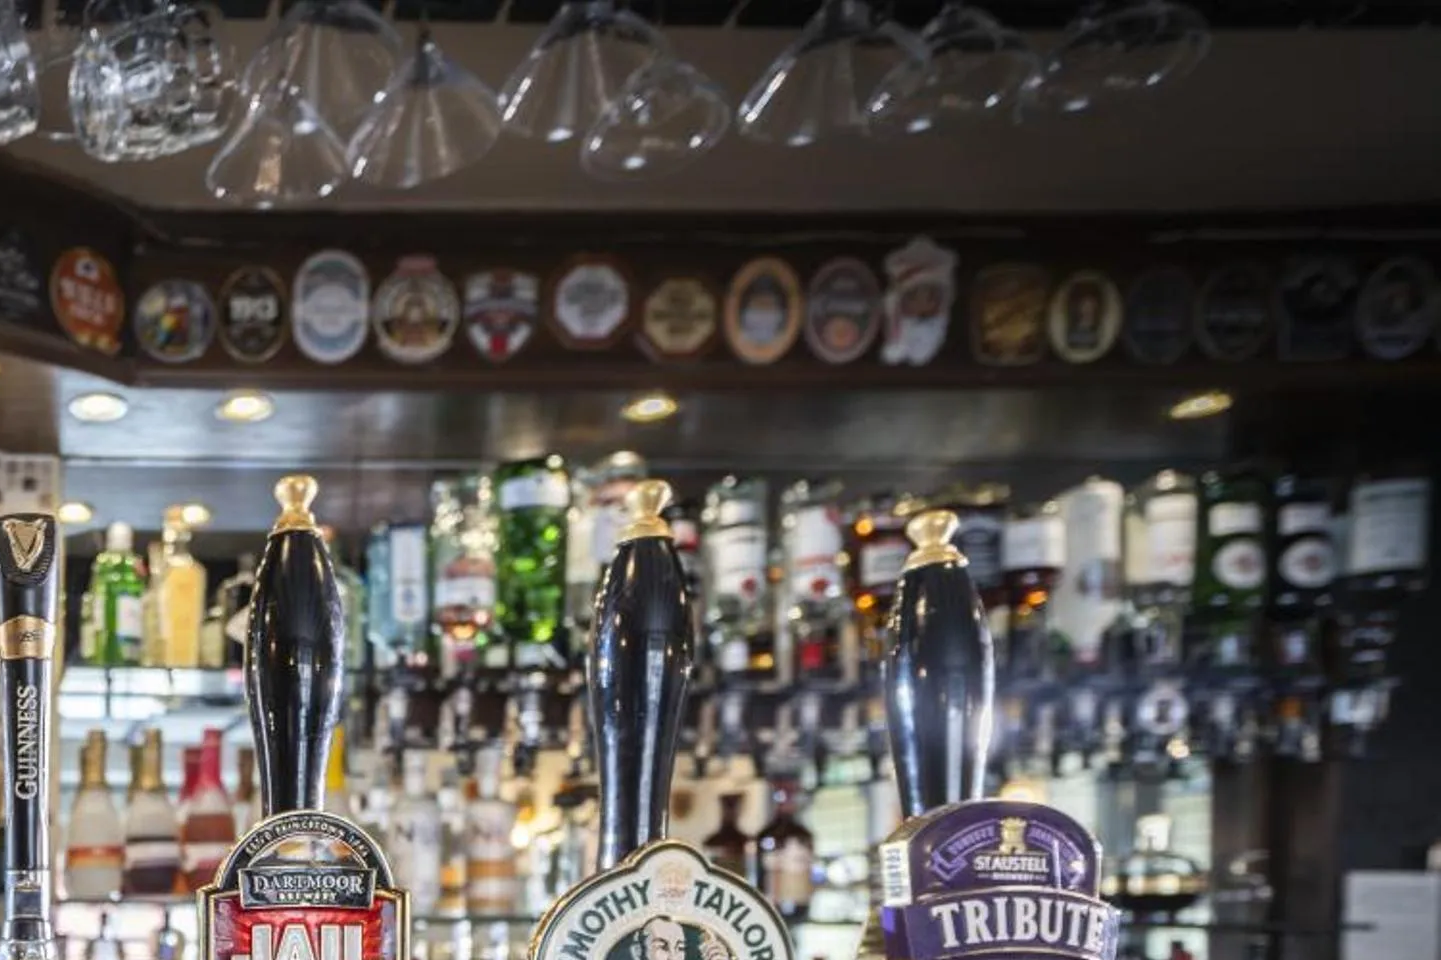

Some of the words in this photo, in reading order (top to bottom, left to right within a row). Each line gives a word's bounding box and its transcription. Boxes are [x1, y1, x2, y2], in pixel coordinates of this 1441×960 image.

[15, 684, 39, 800] GUINNESS
[252, 874, 364, 895] DARTMOOR
[931, 896, 1108, 951] TRIBUTE
